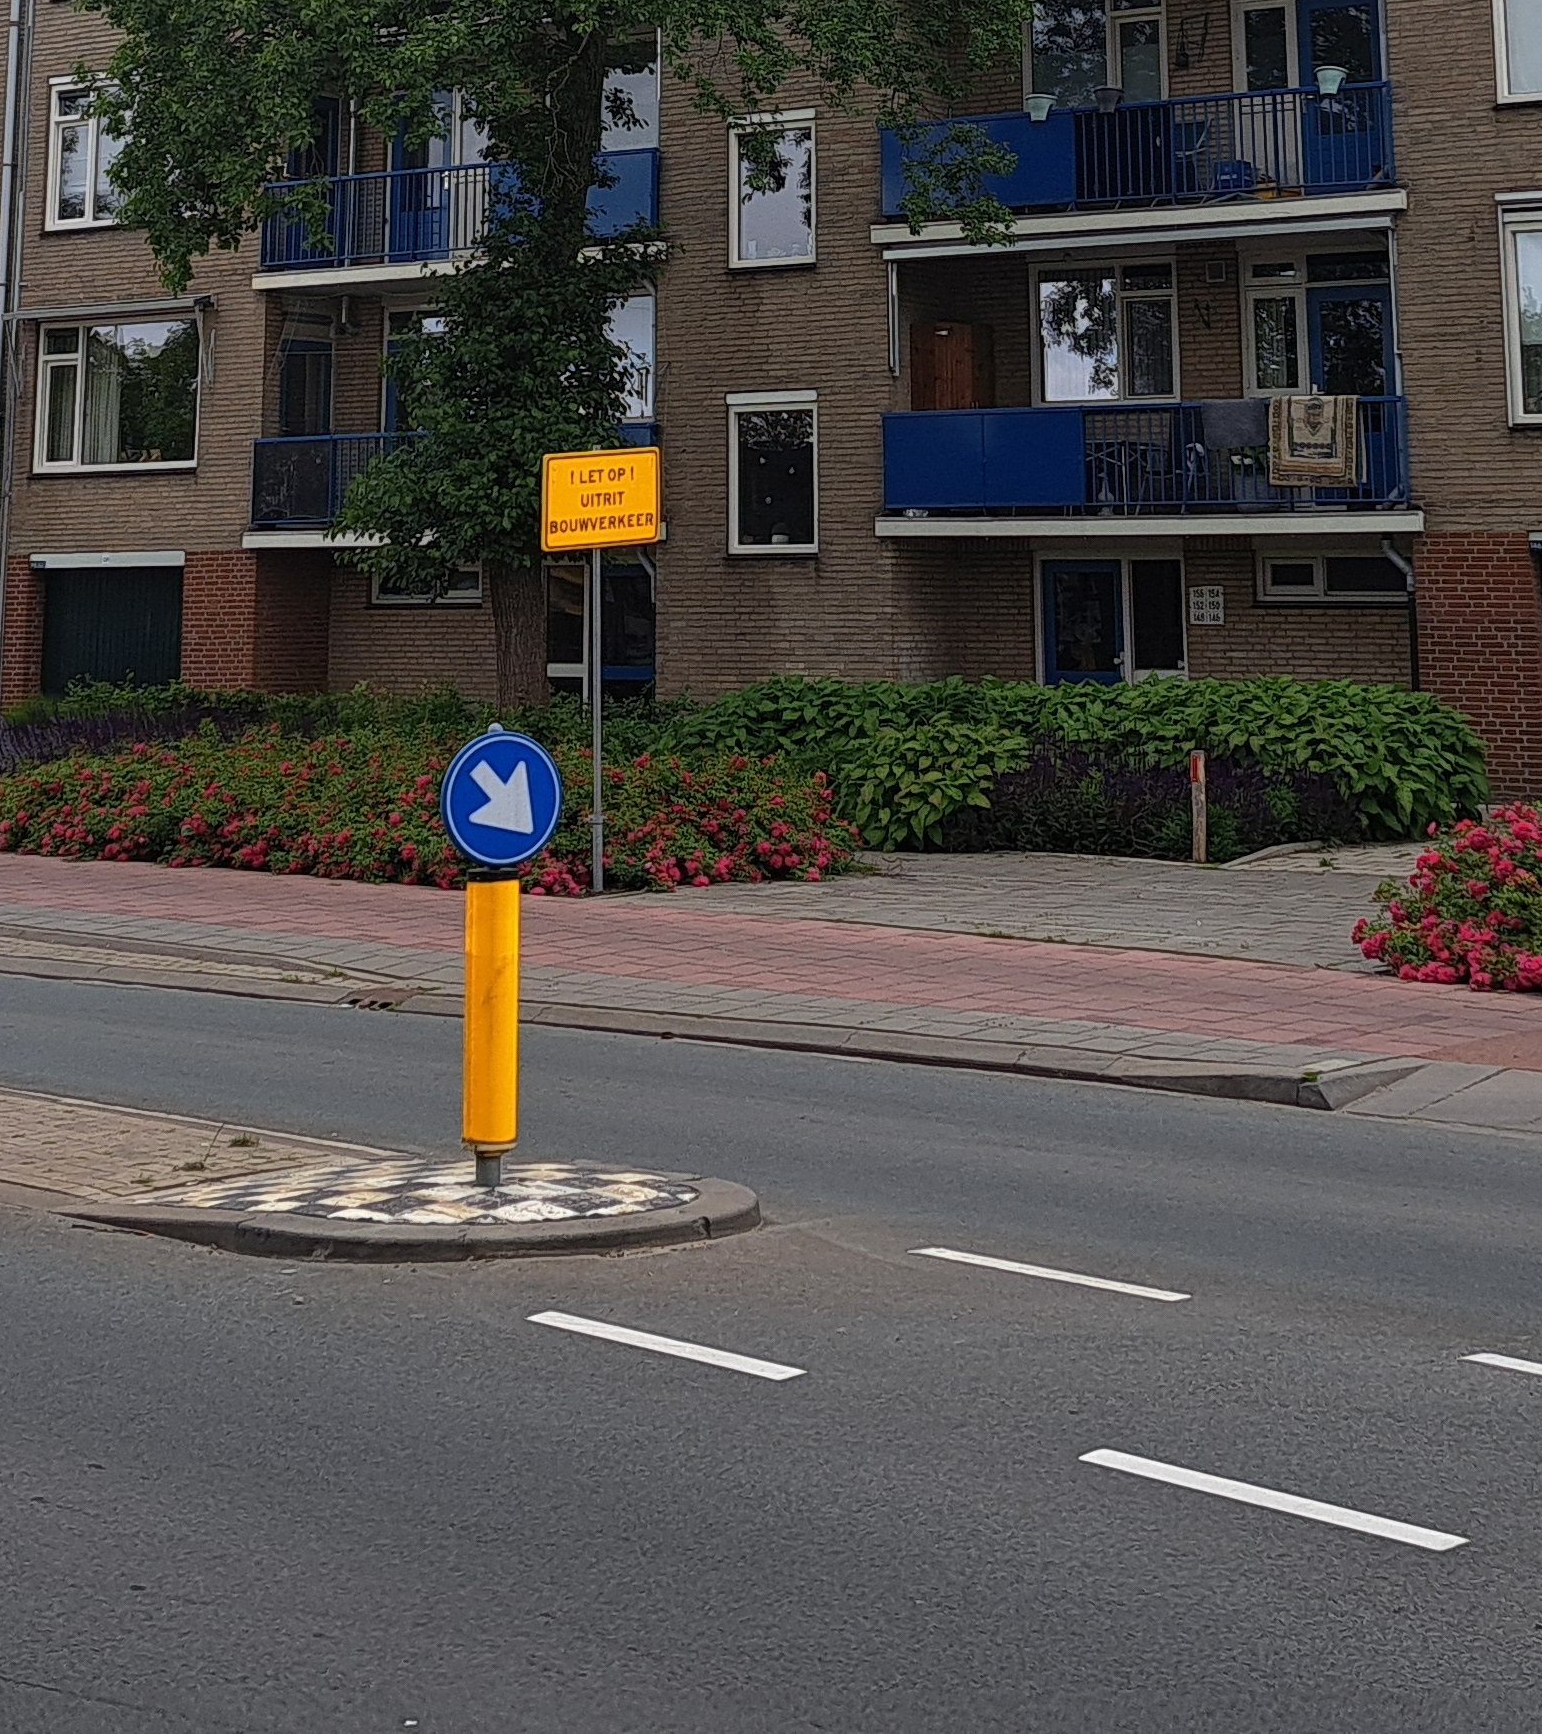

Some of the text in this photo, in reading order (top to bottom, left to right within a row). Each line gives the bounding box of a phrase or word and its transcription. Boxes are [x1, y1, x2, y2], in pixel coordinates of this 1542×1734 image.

[579, 469, 604, 484] LET
[607, 467, 626, 482] OP
[580, 491, 625, 508] UITRIT
[549, 513, 654, 534] BOUWVERKEER
[1193, 600, 1204, 610] 152
